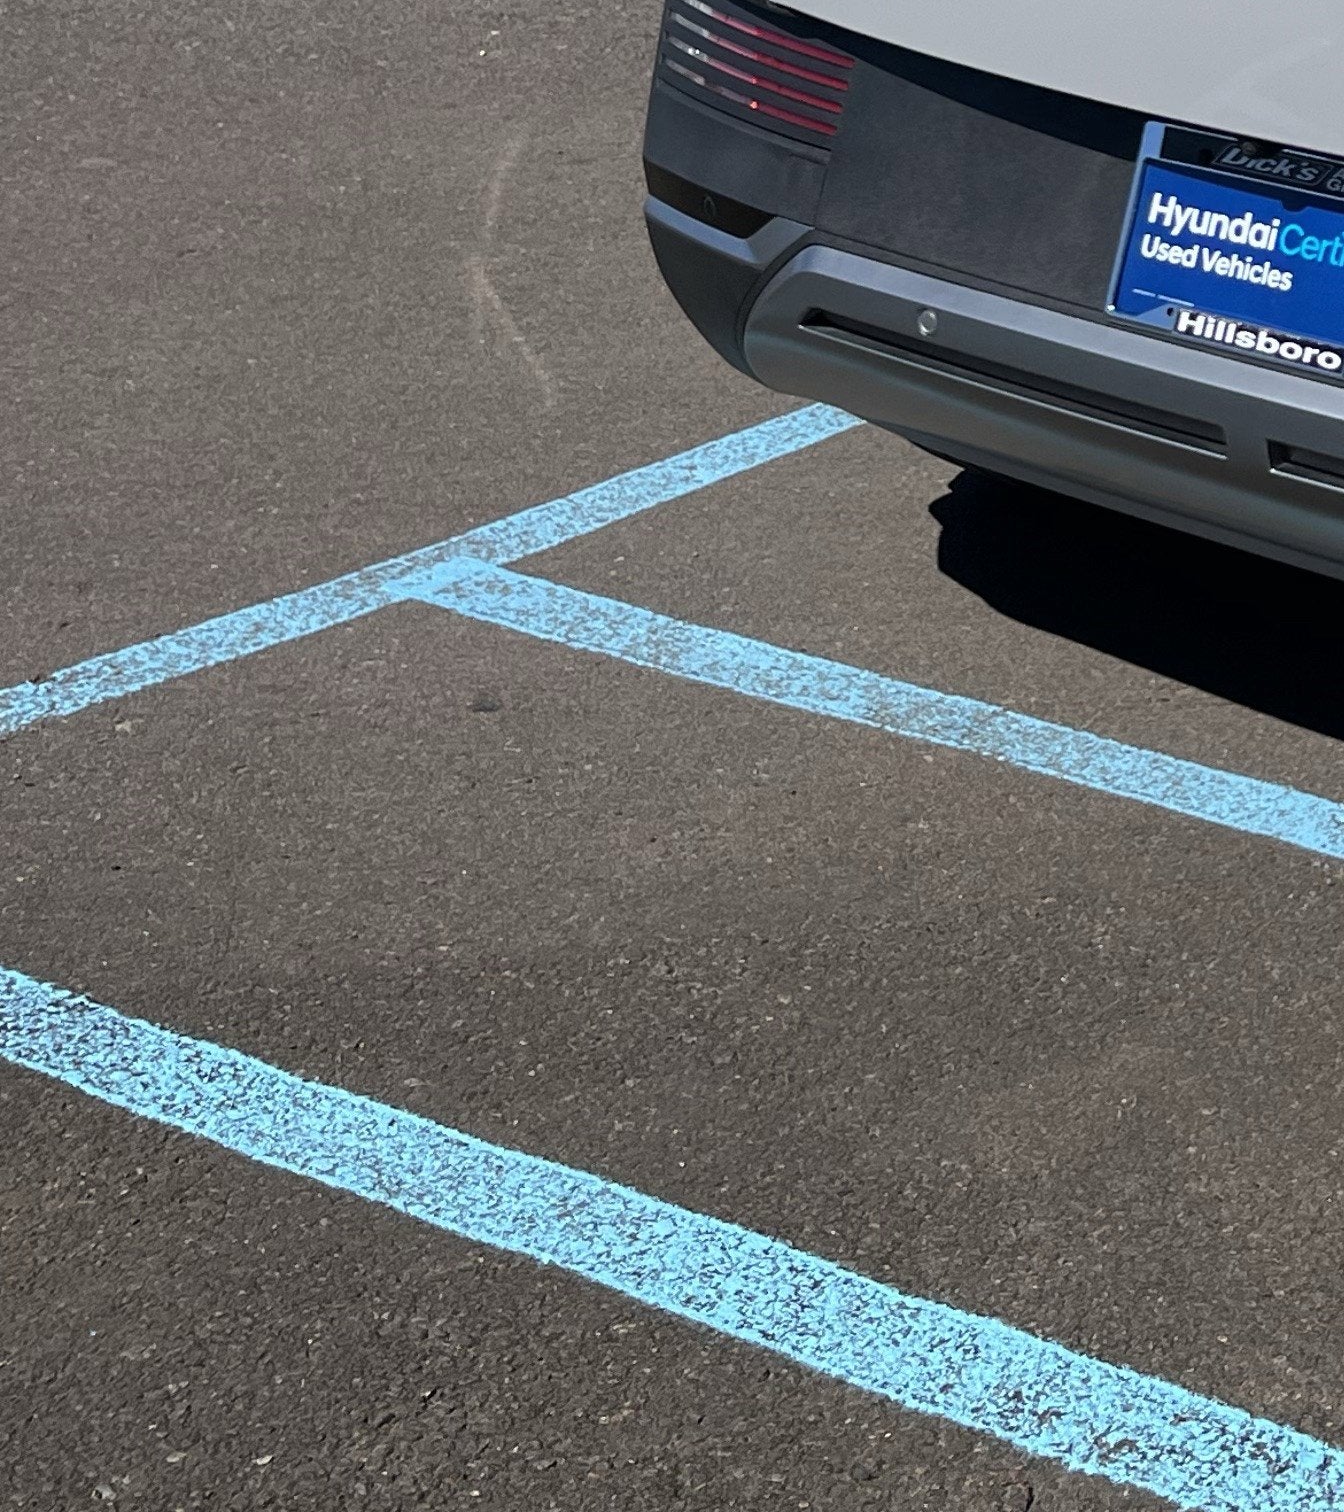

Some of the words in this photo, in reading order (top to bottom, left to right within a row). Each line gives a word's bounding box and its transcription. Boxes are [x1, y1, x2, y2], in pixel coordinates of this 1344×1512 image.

[1147, 192, 1281, 252] Hyundai
[1141, 233, 1200, 269] Used
[1201, 246, 1294, 291] Vehicles
[1178, 311, 1343, 371] Hillsboro
